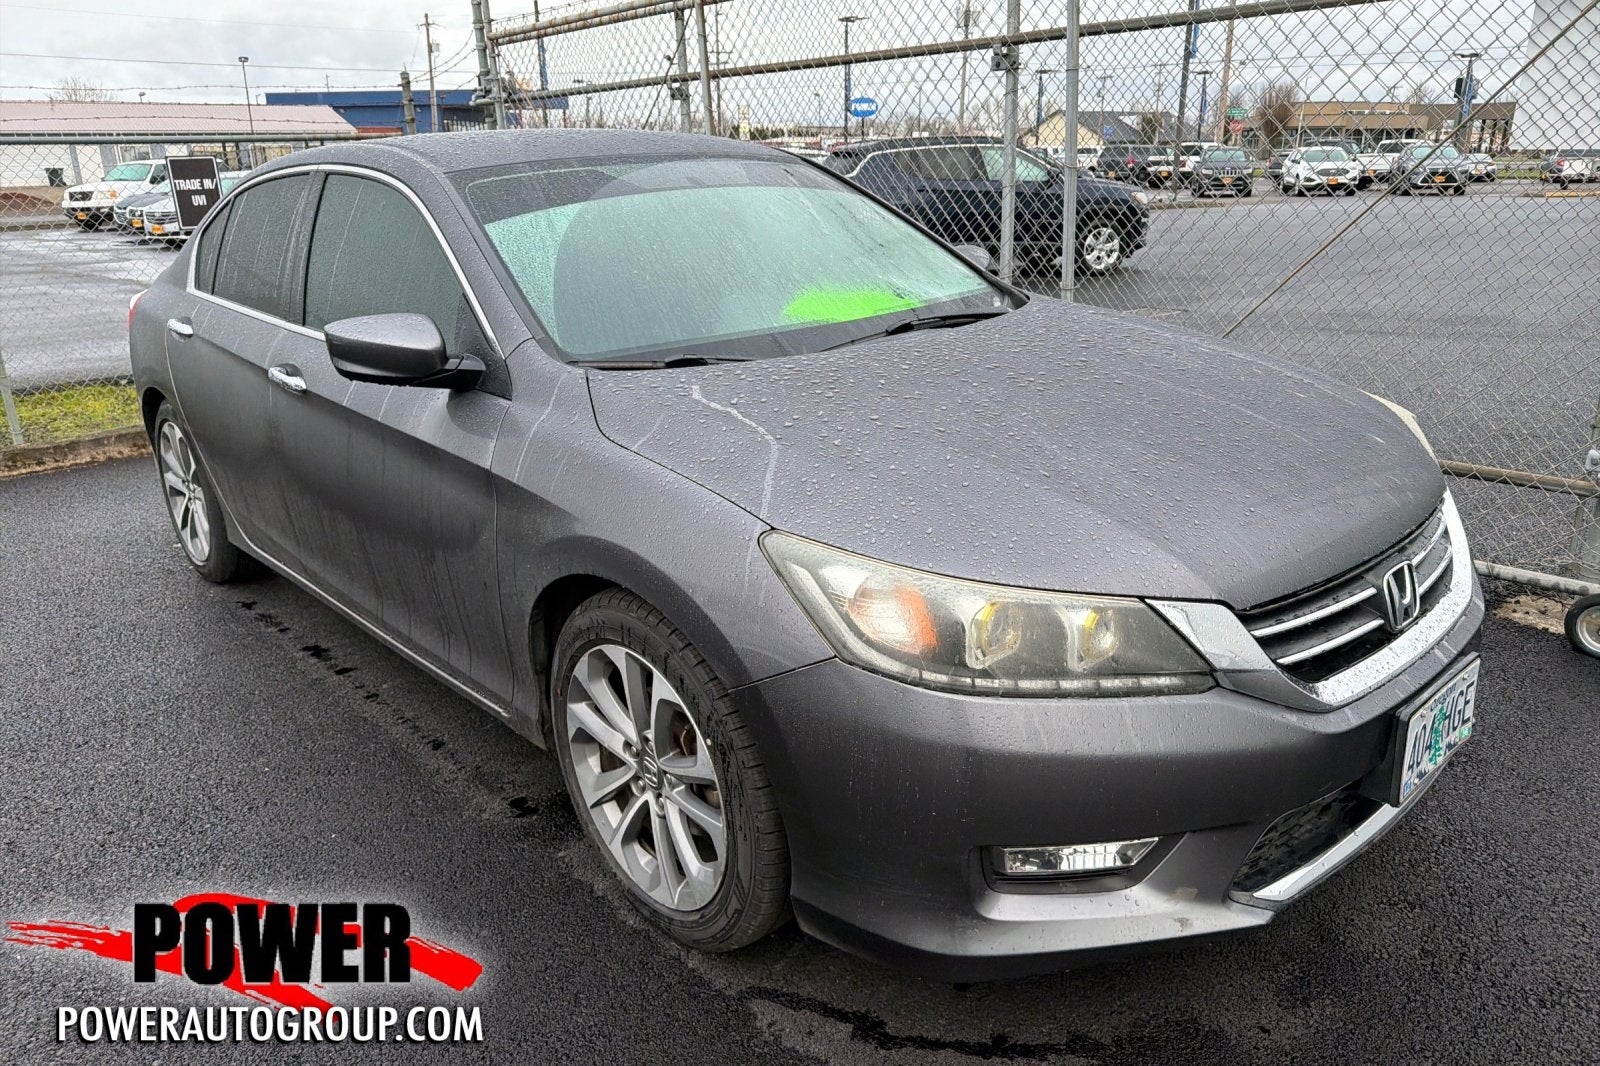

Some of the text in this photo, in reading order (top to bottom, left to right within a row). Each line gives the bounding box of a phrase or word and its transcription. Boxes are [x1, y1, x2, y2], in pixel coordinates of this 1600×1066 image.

[174, 178, 217, 191] TRADE IN/
[191, 194, 207, 206] UVI
[1440, 680, 1475, 740] HGE
